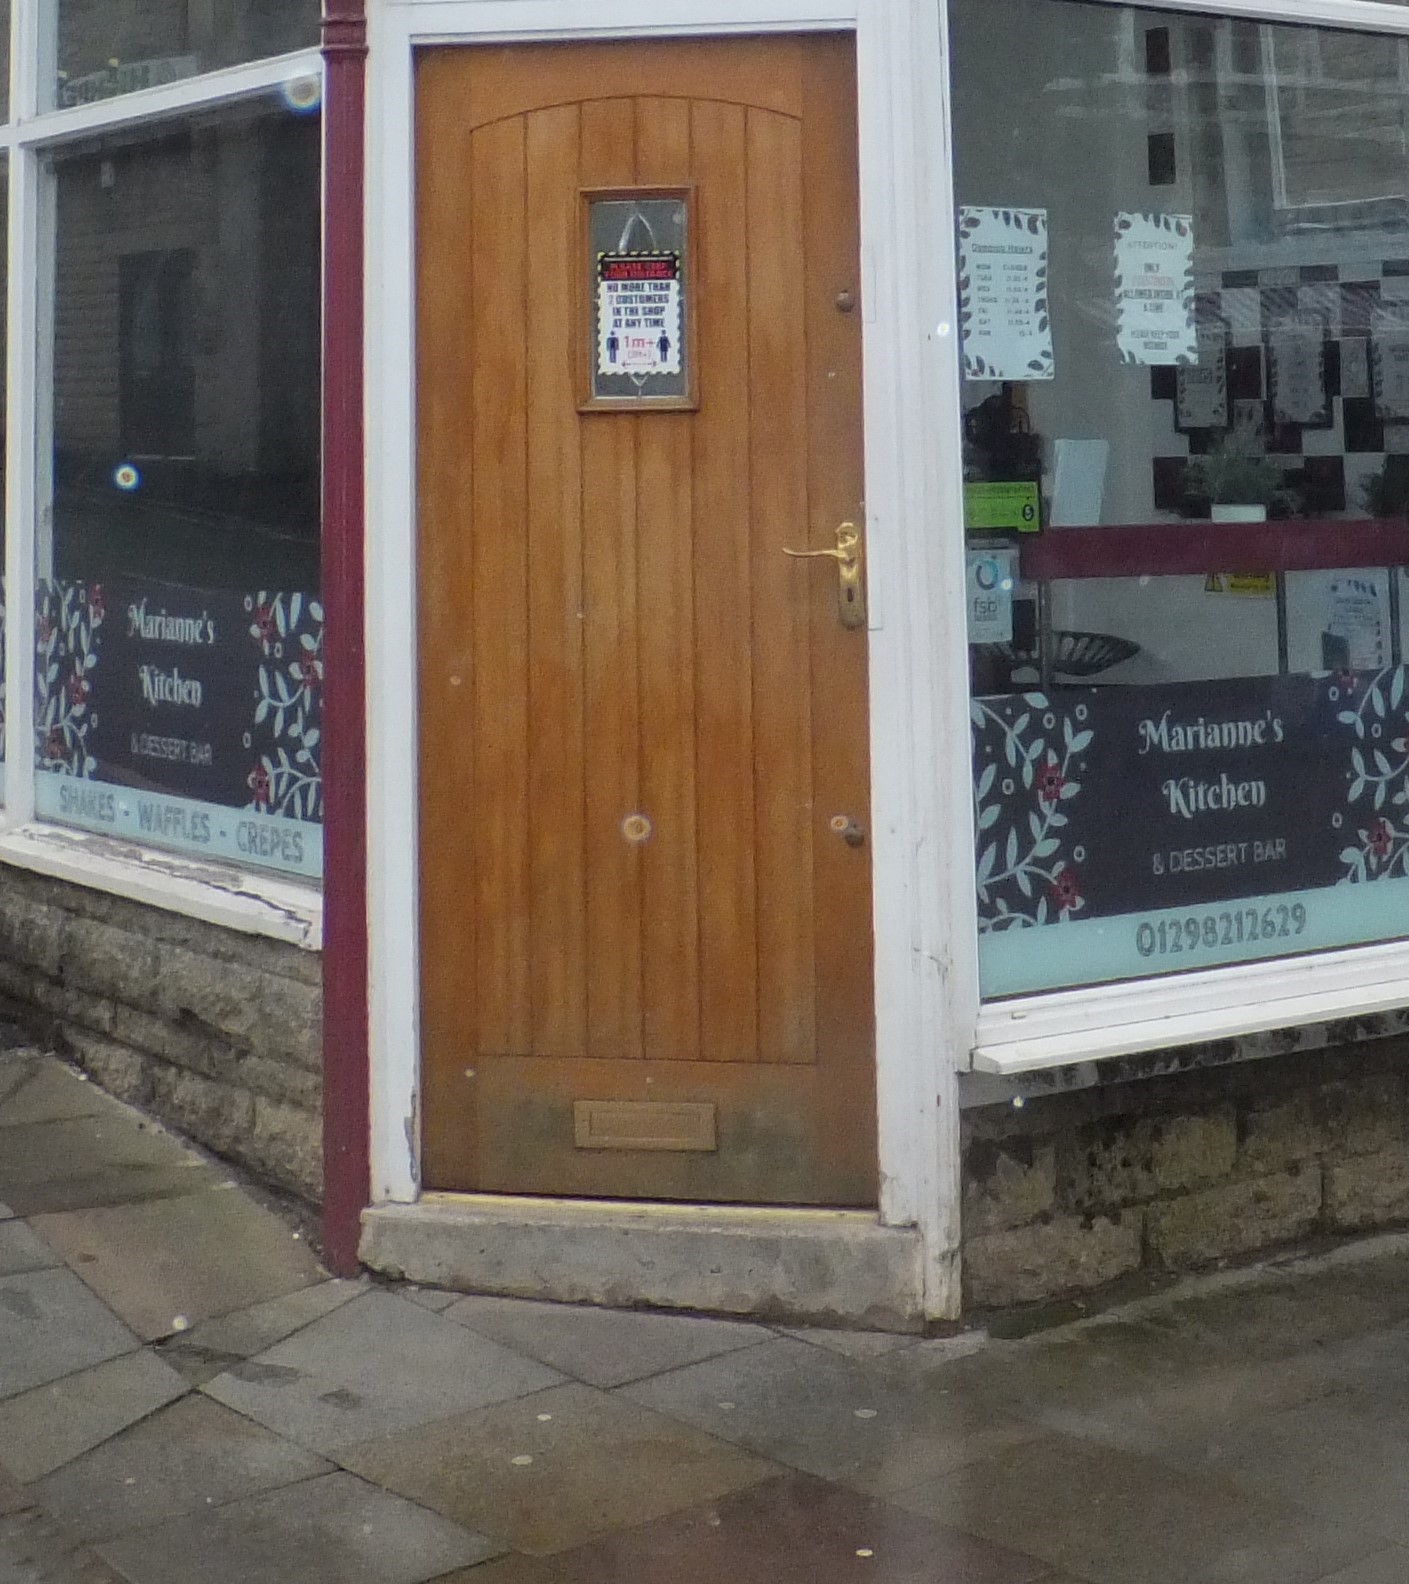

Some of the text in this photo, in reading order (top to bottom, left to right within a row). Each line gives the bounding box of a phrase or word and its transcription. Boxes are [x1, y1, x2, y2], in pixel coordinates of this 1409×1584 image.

[606, 282, 671, 292] NO MORE THAN
[616, 294, 669, 304] CUSTOMERS
[612, 306, 666, 316] IN THE SHOP
[612, 318, 665, 328] AT ANY TIME
[128, 597, 214, 645] Marianne's
[139, 665, 202, 708] Kitchen
[1138, 709, 1284, 755] Marianne's
[1162, 773, 1266, 819] Kitchen
[138, 799, 211, 843] WAFFLES
[236, 820, 304, 864] CREPES
[1152, 838, 1287, 875] & DESSERT BAR
[1136, 902, 1307, 958] 01298212629
